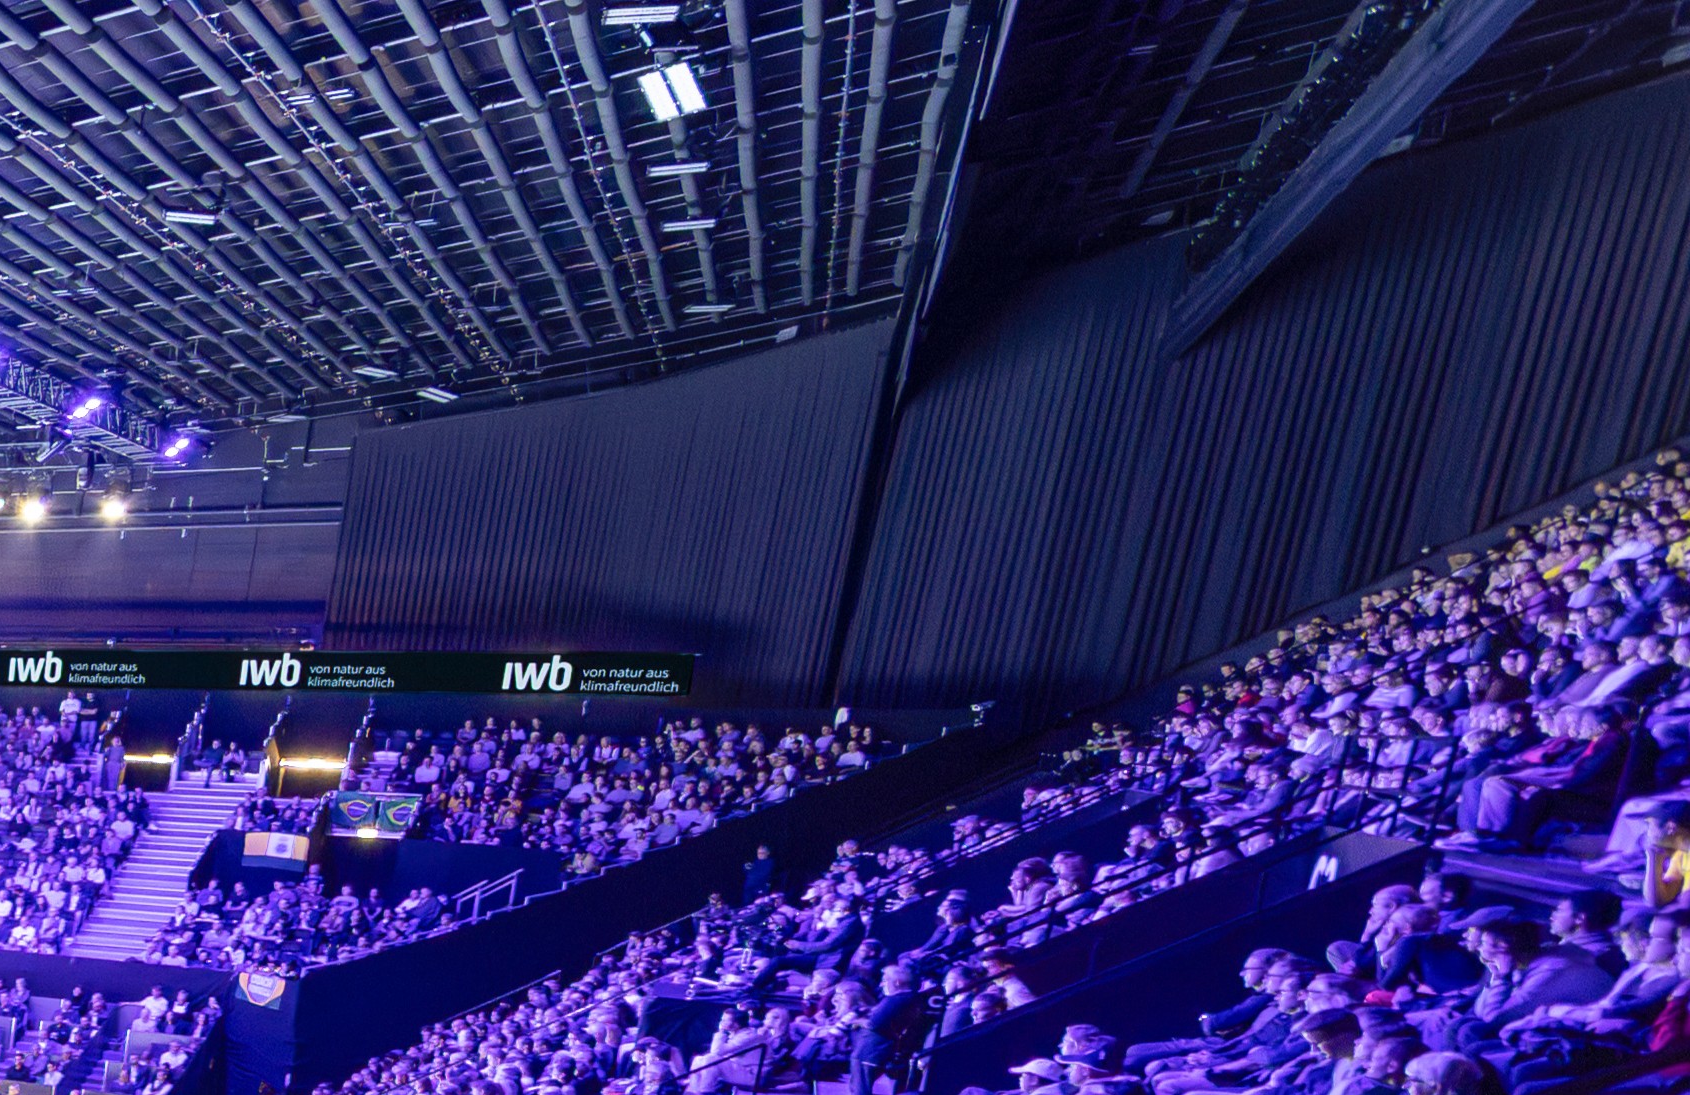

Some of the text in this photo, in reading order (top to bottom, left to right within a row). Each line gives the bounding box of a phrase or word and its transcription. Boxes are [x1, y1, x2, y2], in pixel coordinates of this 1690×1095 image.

[70, 662, 137, 672] von natur aus
[309, 664, 386, 675] von natur aus
[583, 667, 669, 678] von natur aus
[69, 672, 145, 684] klimafreundlich
[307, 675, 395, 689] klimafreundlich
[580, 678, 679, 694] klimafreundlich
